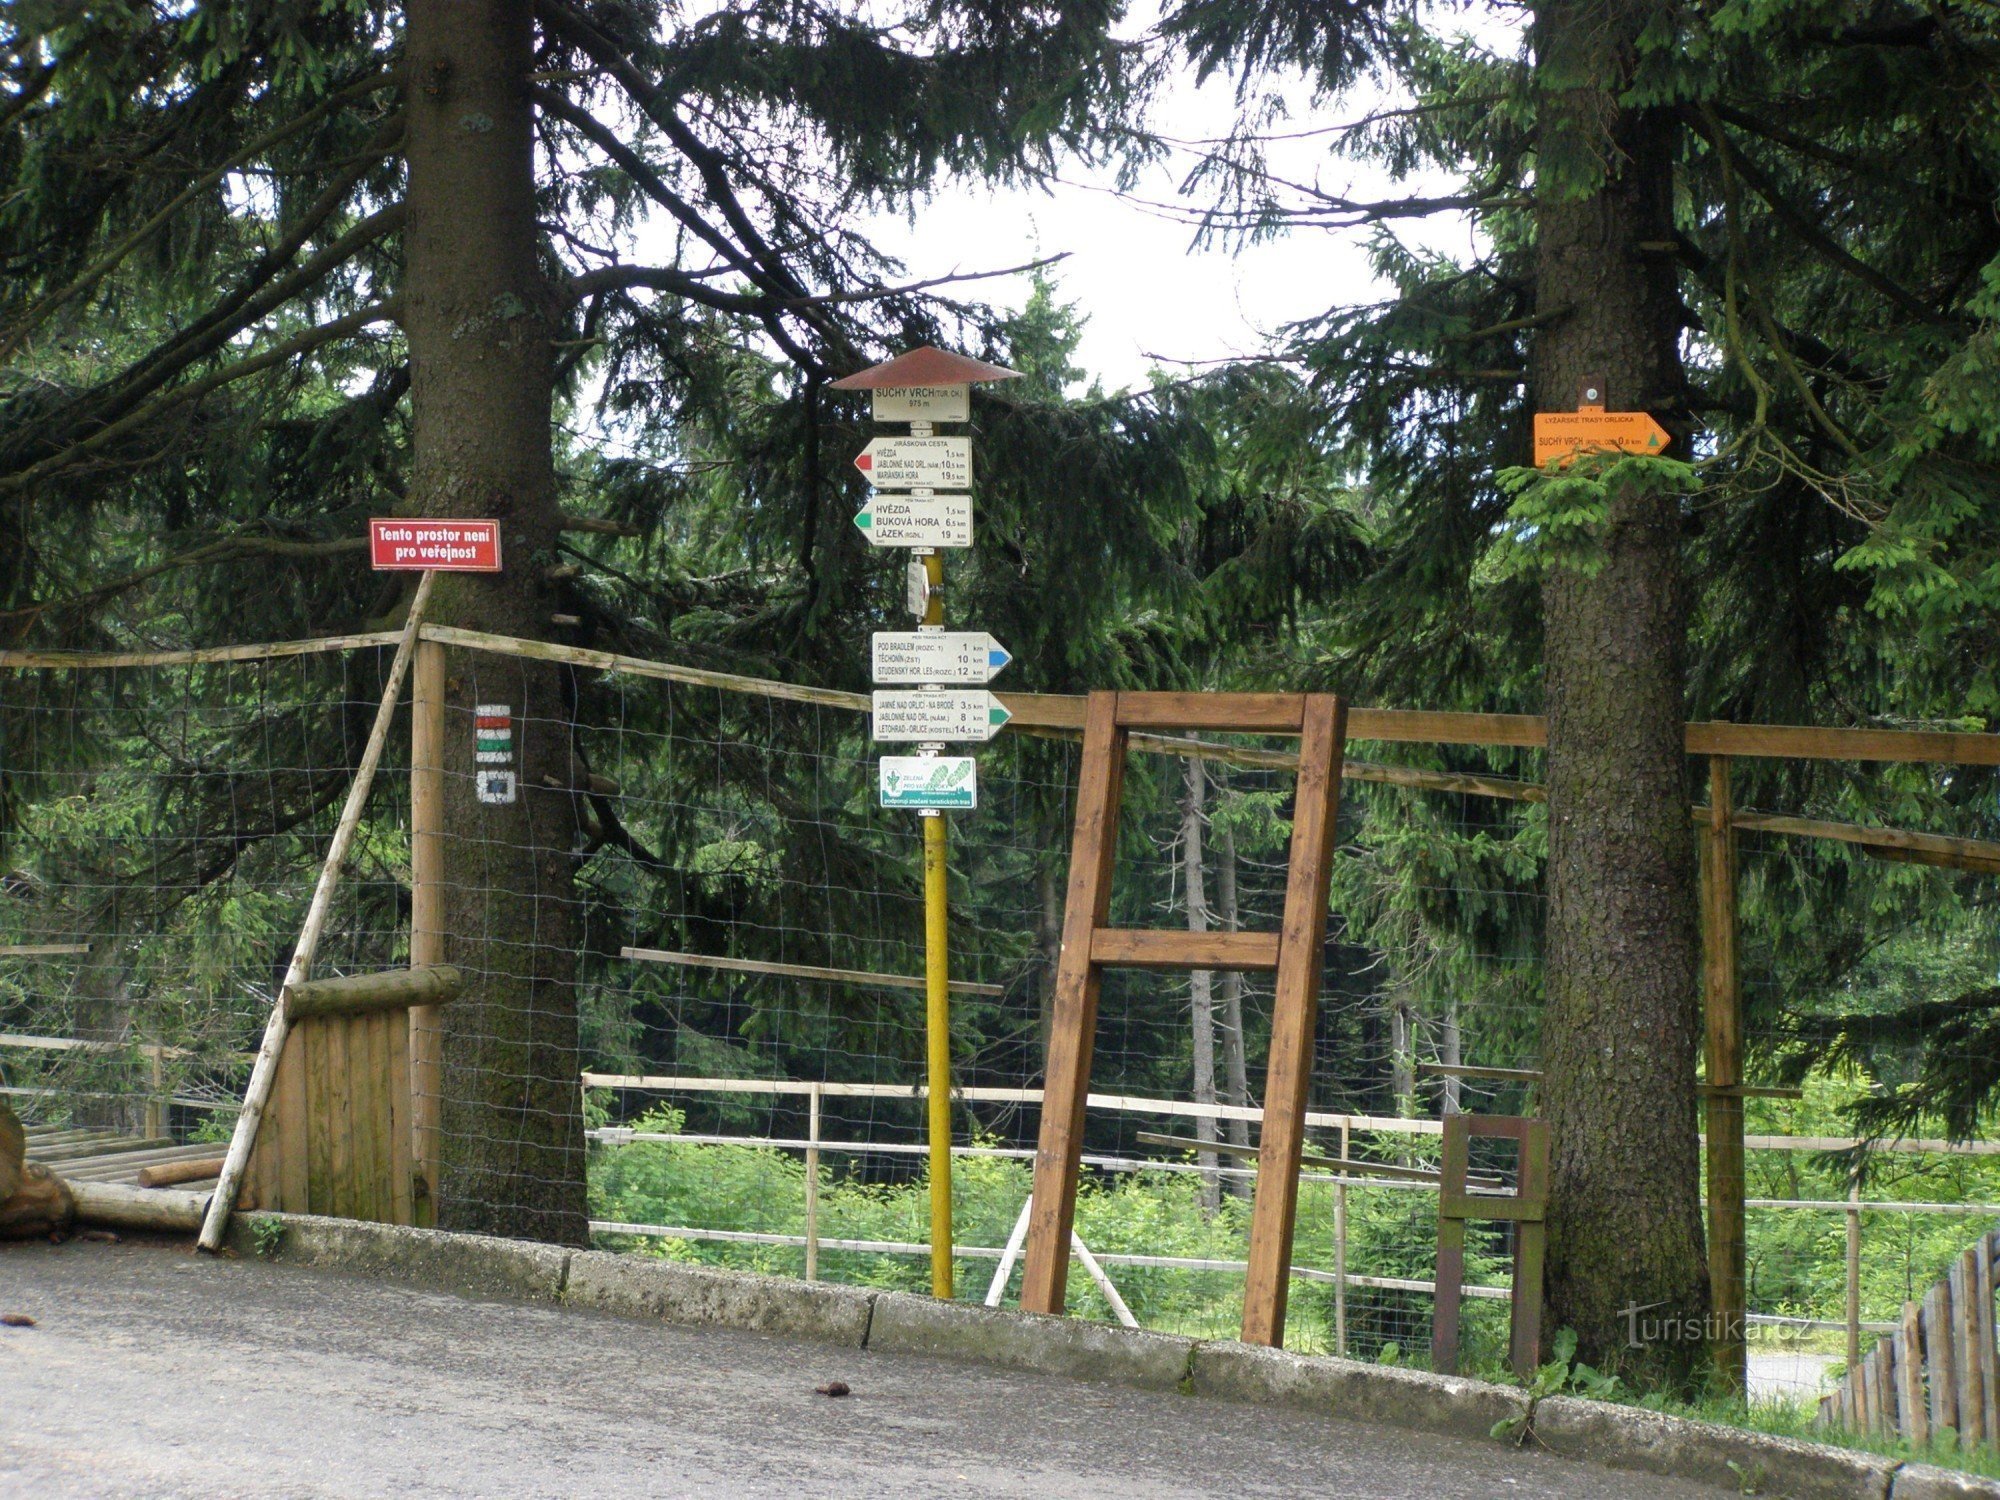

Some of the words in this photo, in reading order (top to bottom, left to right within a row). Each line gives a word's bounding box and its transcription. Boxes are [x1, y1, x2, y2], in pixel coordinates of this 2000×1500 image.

[910, 388, 935, 398] VRCH
[1564, 437, 1583, 446] VRCH
[876, 505, 910, 514] HVĚZDA
[876, 517, 912, 526] BUKOVÁ
[914, 518, 940, 526] HORA
[379, 526, 412, 541] Tento
[416, 528, 460, 545] prostor
[464, 528, 490, 542] není
[876, 529, 904, 538] LÁZEK
[941, 530, 951, 539] 19
[396, 546, 416, 561] pro
[420, 544, 476, 562] veřejnost
[878, 643, 890, 651] POD
[963, 643, 968, 651] 1
[958, 655, 968, 664] 10
[923, 667, 933, 675] LES
[957, 668, 968, 676] 12
[896, 702, 907, 710] NAD
[928, 702, 936, 710] NA
[906, 713, 917, 721] NAD
[960, 714, 966, 722] 8
